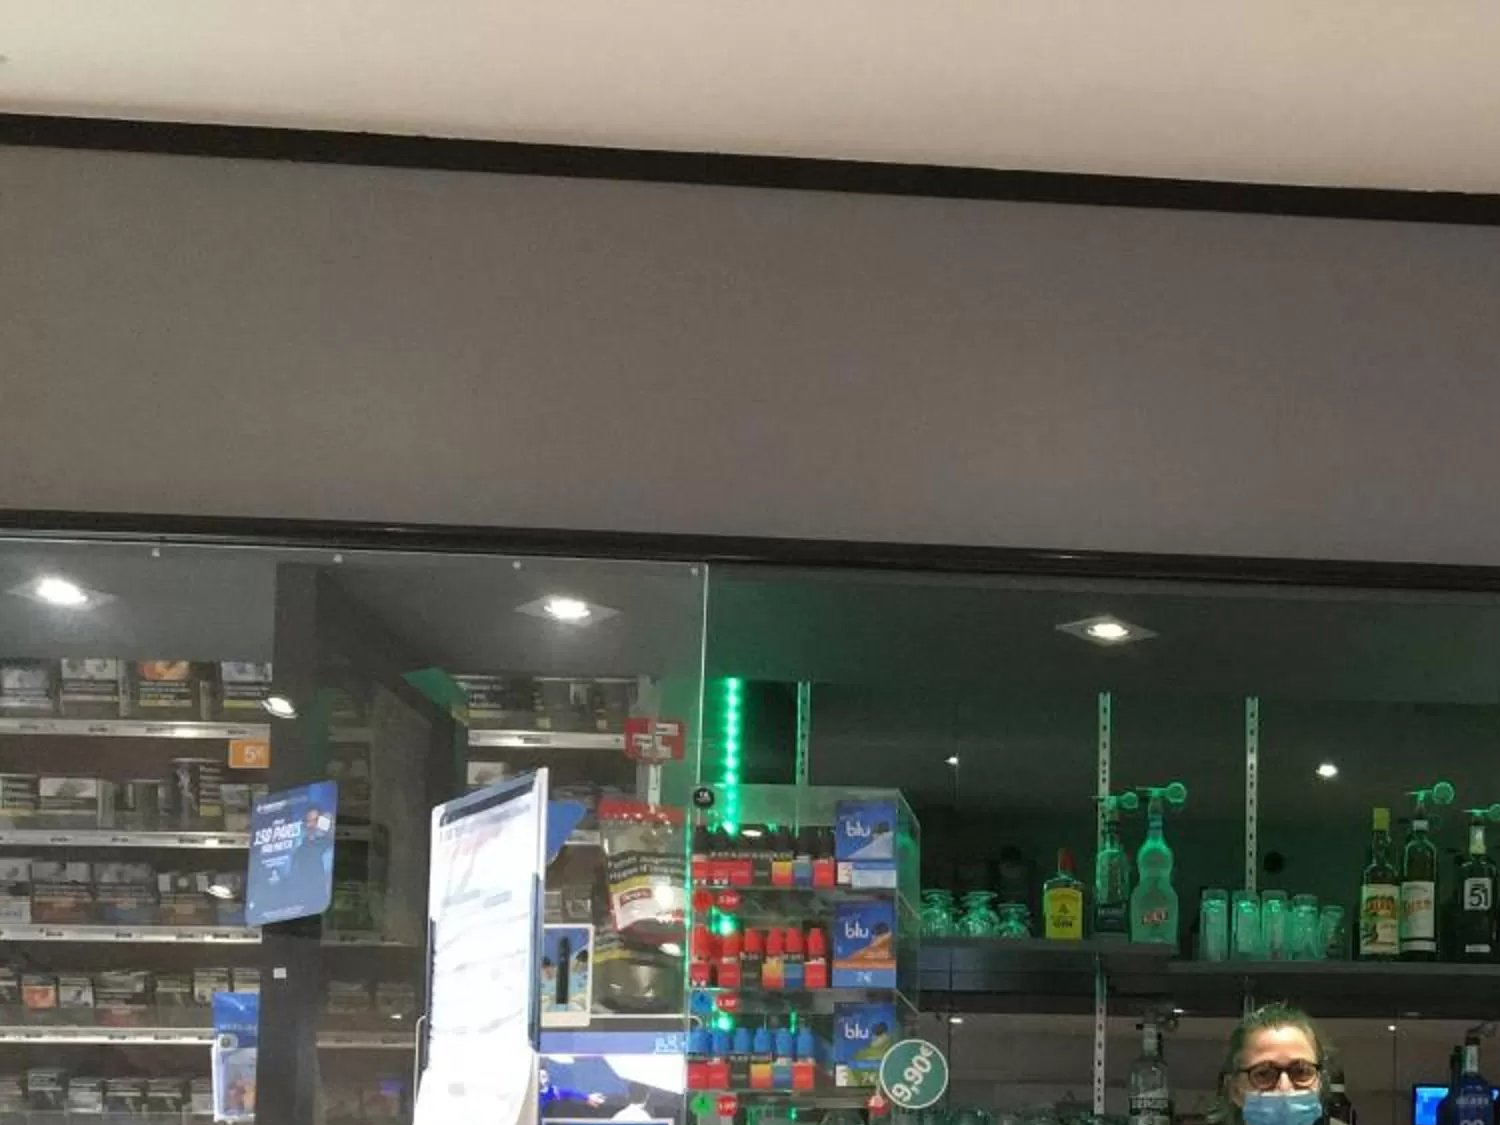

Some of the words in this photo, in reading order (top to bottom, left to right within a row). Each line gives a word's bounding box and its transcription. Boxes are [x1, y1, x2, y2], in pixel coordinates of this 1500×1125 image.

[845, 821, 870, 837] blu
[1471, 884, 1488, 907] 51
[845, 921, 869, 938] blu
[844, 1022, 869, 1039] blu
[890, 1045, 935, 1102] 9,90€
